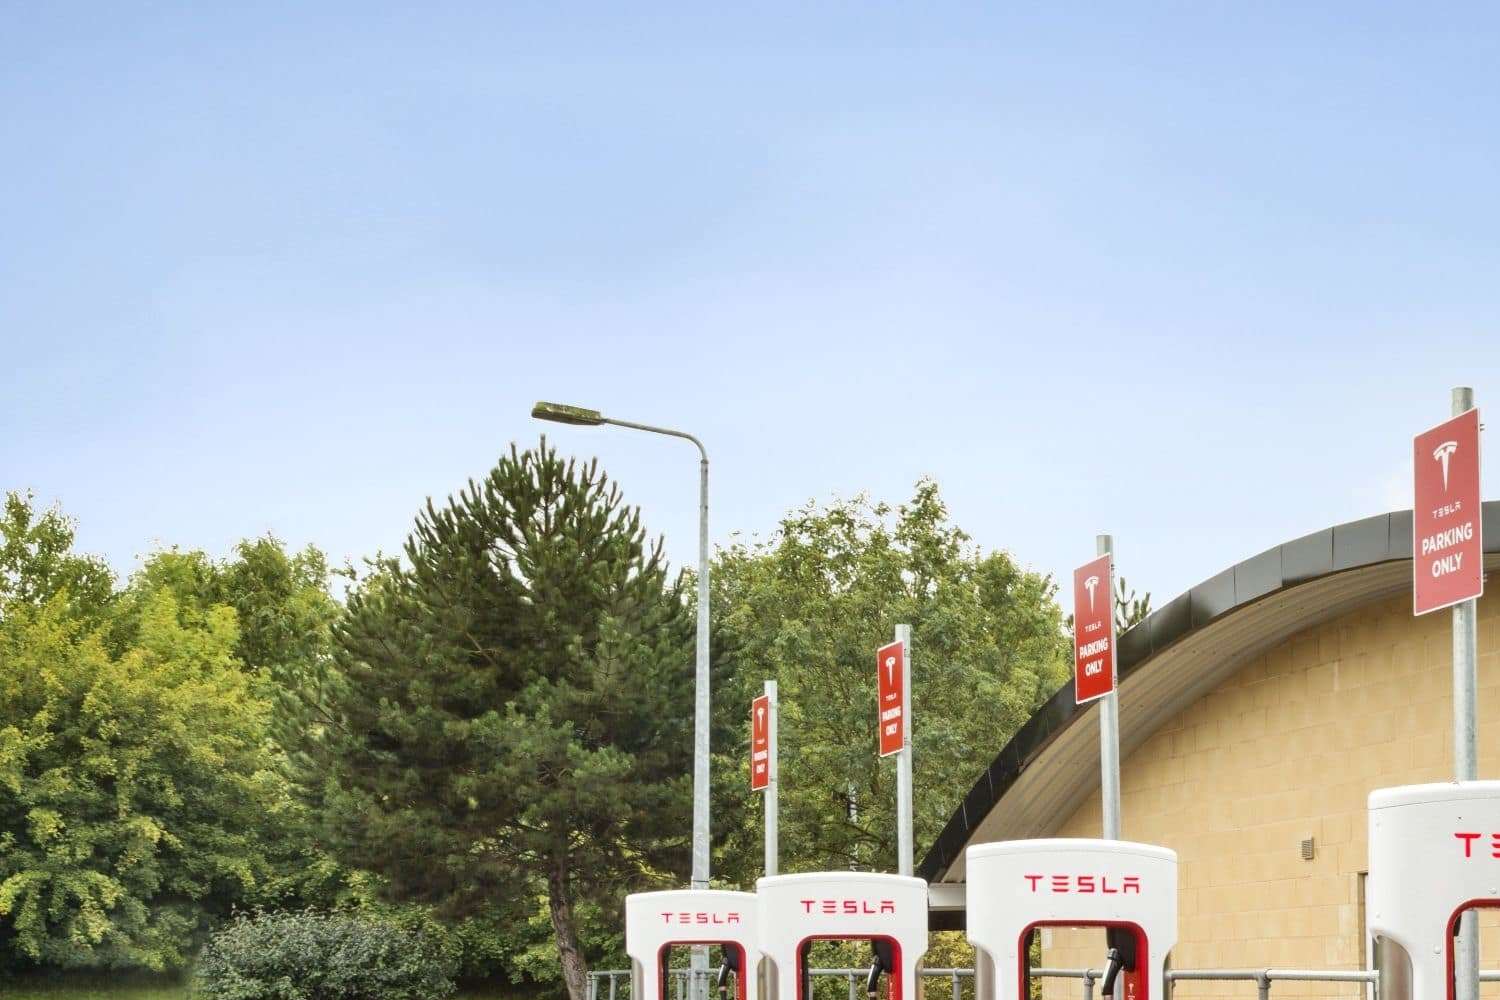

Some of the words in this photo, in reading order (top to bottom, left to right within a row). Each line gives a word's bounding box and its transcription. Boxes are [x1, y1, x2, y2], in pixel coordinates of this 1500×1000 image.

[1432, 500, 1462, 520] TESLA
[1422, 522, 1473, 556] PARKING
[1432, 552, 1463, 578] ONLY
[1085, 657, 1103, 677] ONLY
[1024, 874, 1142, 894] TESLA
[800, 899, 895, 915] TESLA
[661, 912, 741, 924] TESLA
